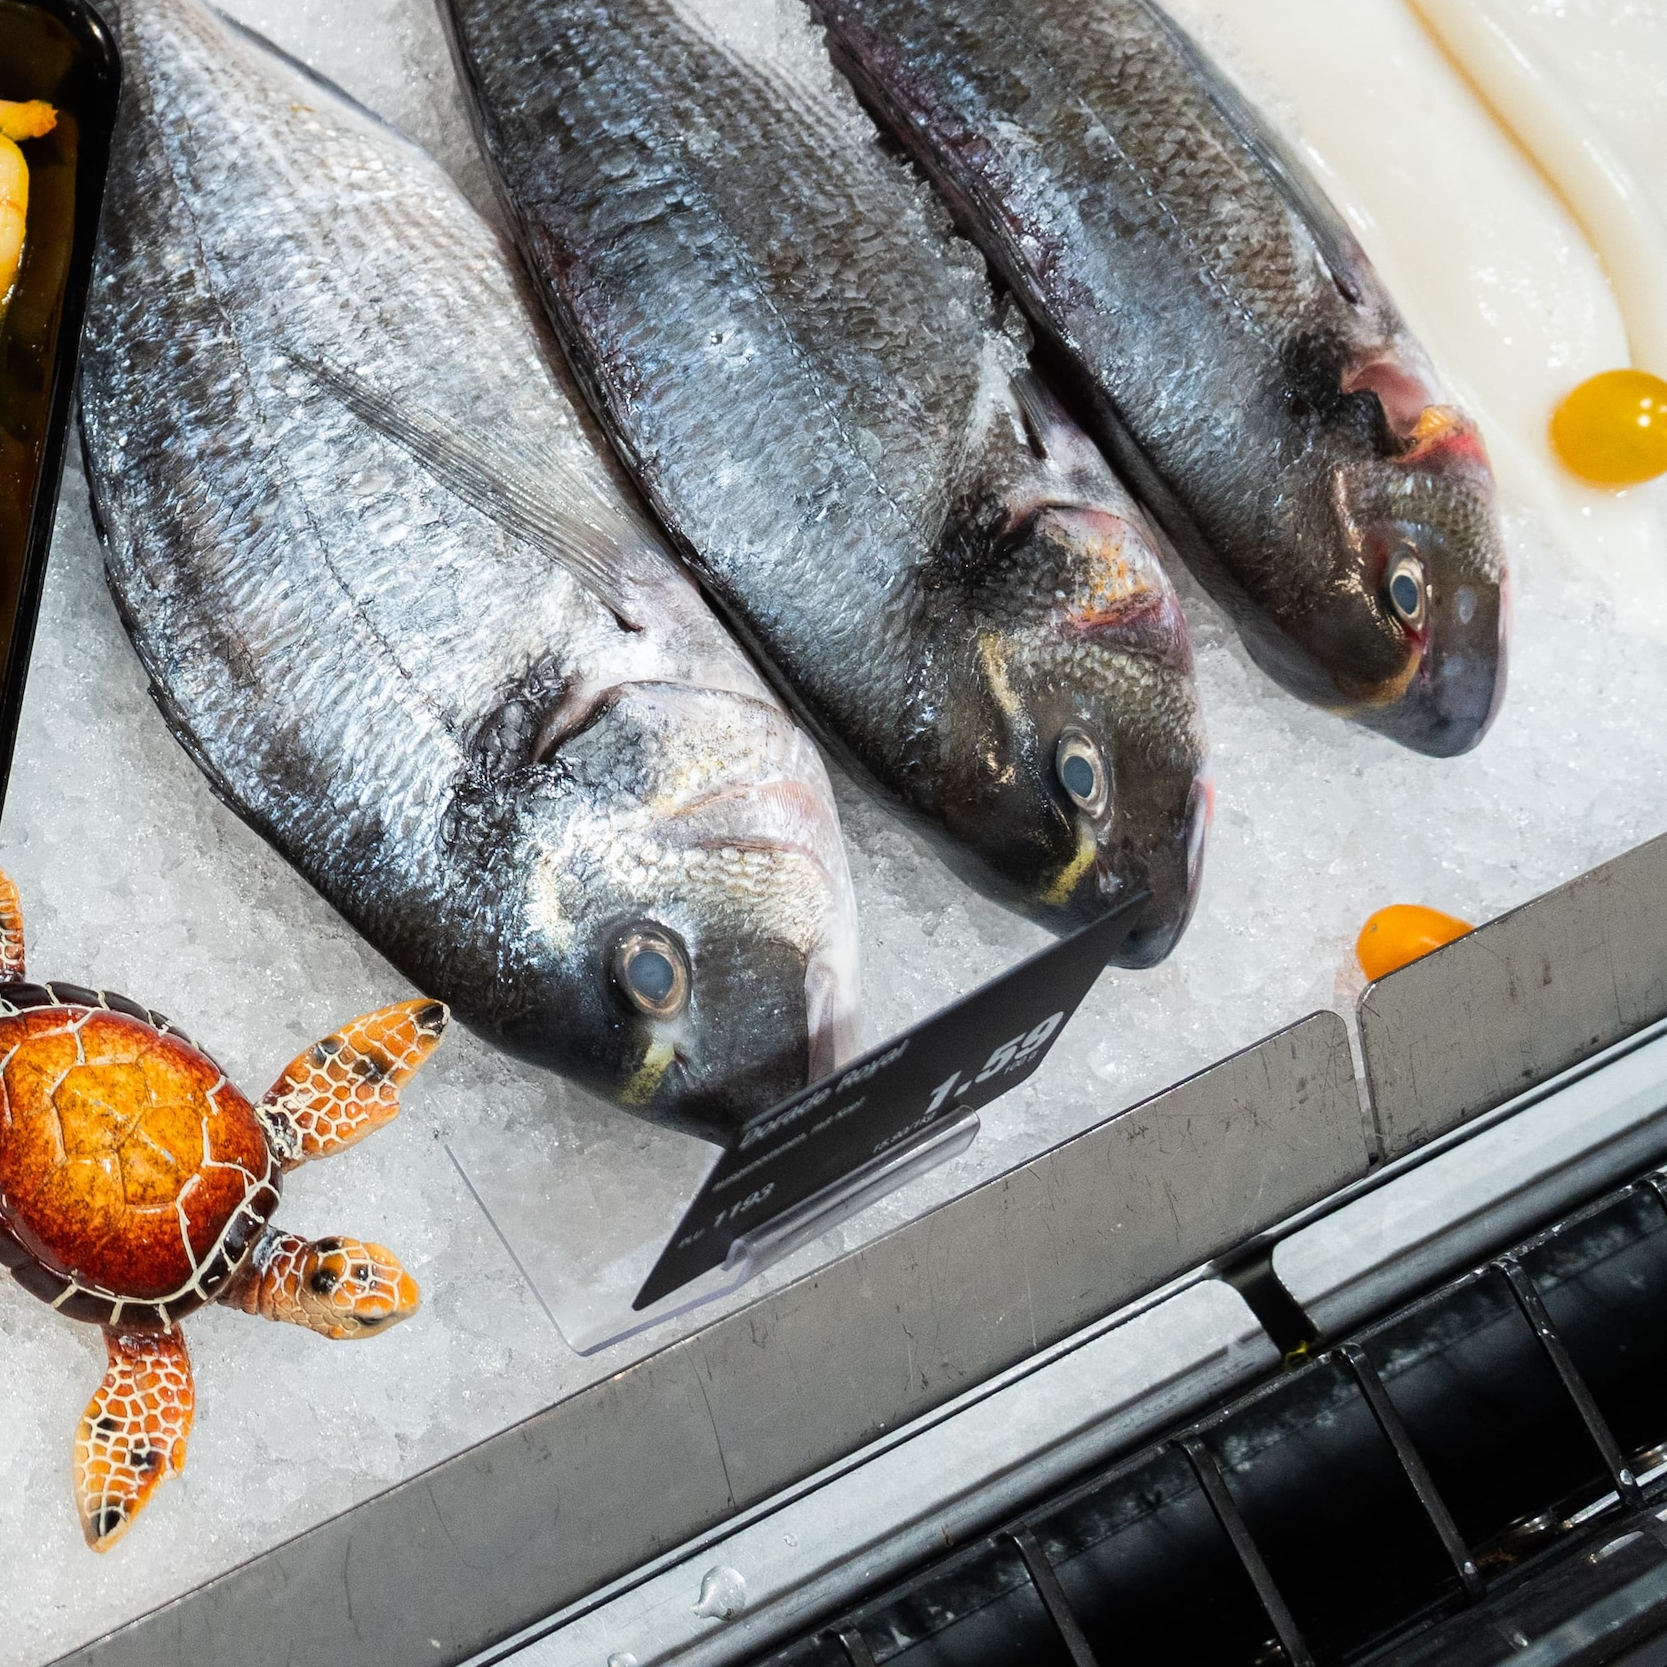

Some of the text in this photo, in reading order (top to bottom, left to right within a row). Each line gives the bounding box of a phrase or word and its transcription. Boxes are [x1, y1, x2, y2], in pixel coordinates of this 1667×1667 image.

[739, 1039, 909, 1149] Dorade Royal
[925, 1011, 1064, 1114] 1.59
[714, 1183, 774, 1227] 1193
